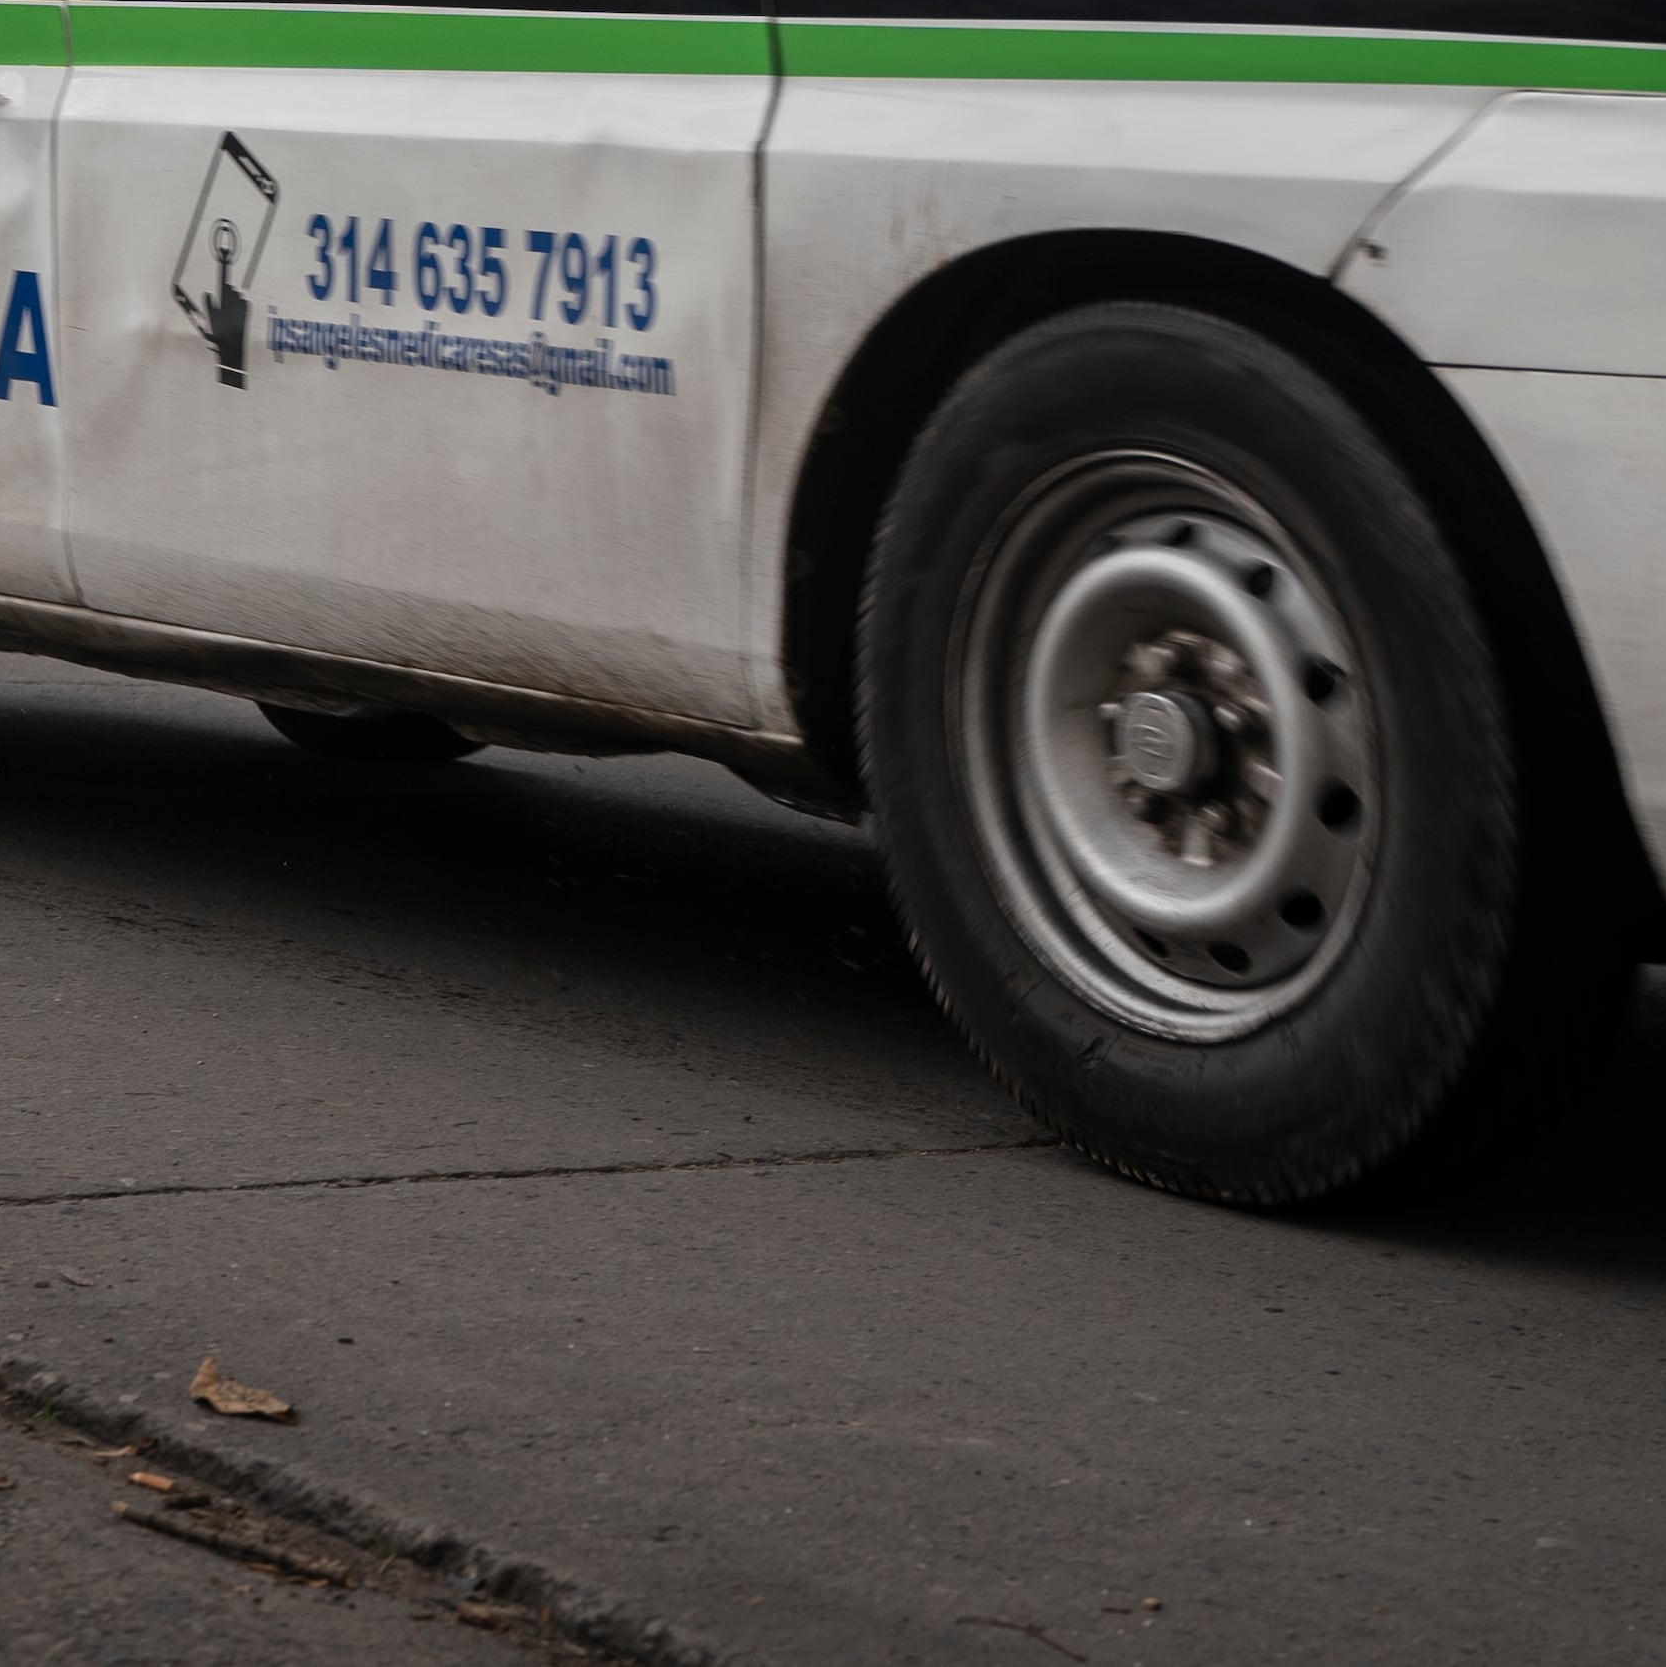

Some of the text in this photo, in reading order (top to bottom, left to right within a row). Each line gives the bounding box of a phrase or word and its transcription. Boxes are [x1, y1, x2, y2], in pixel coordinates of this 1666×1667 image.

[305, 212, 659, 332] 314 635 7913
